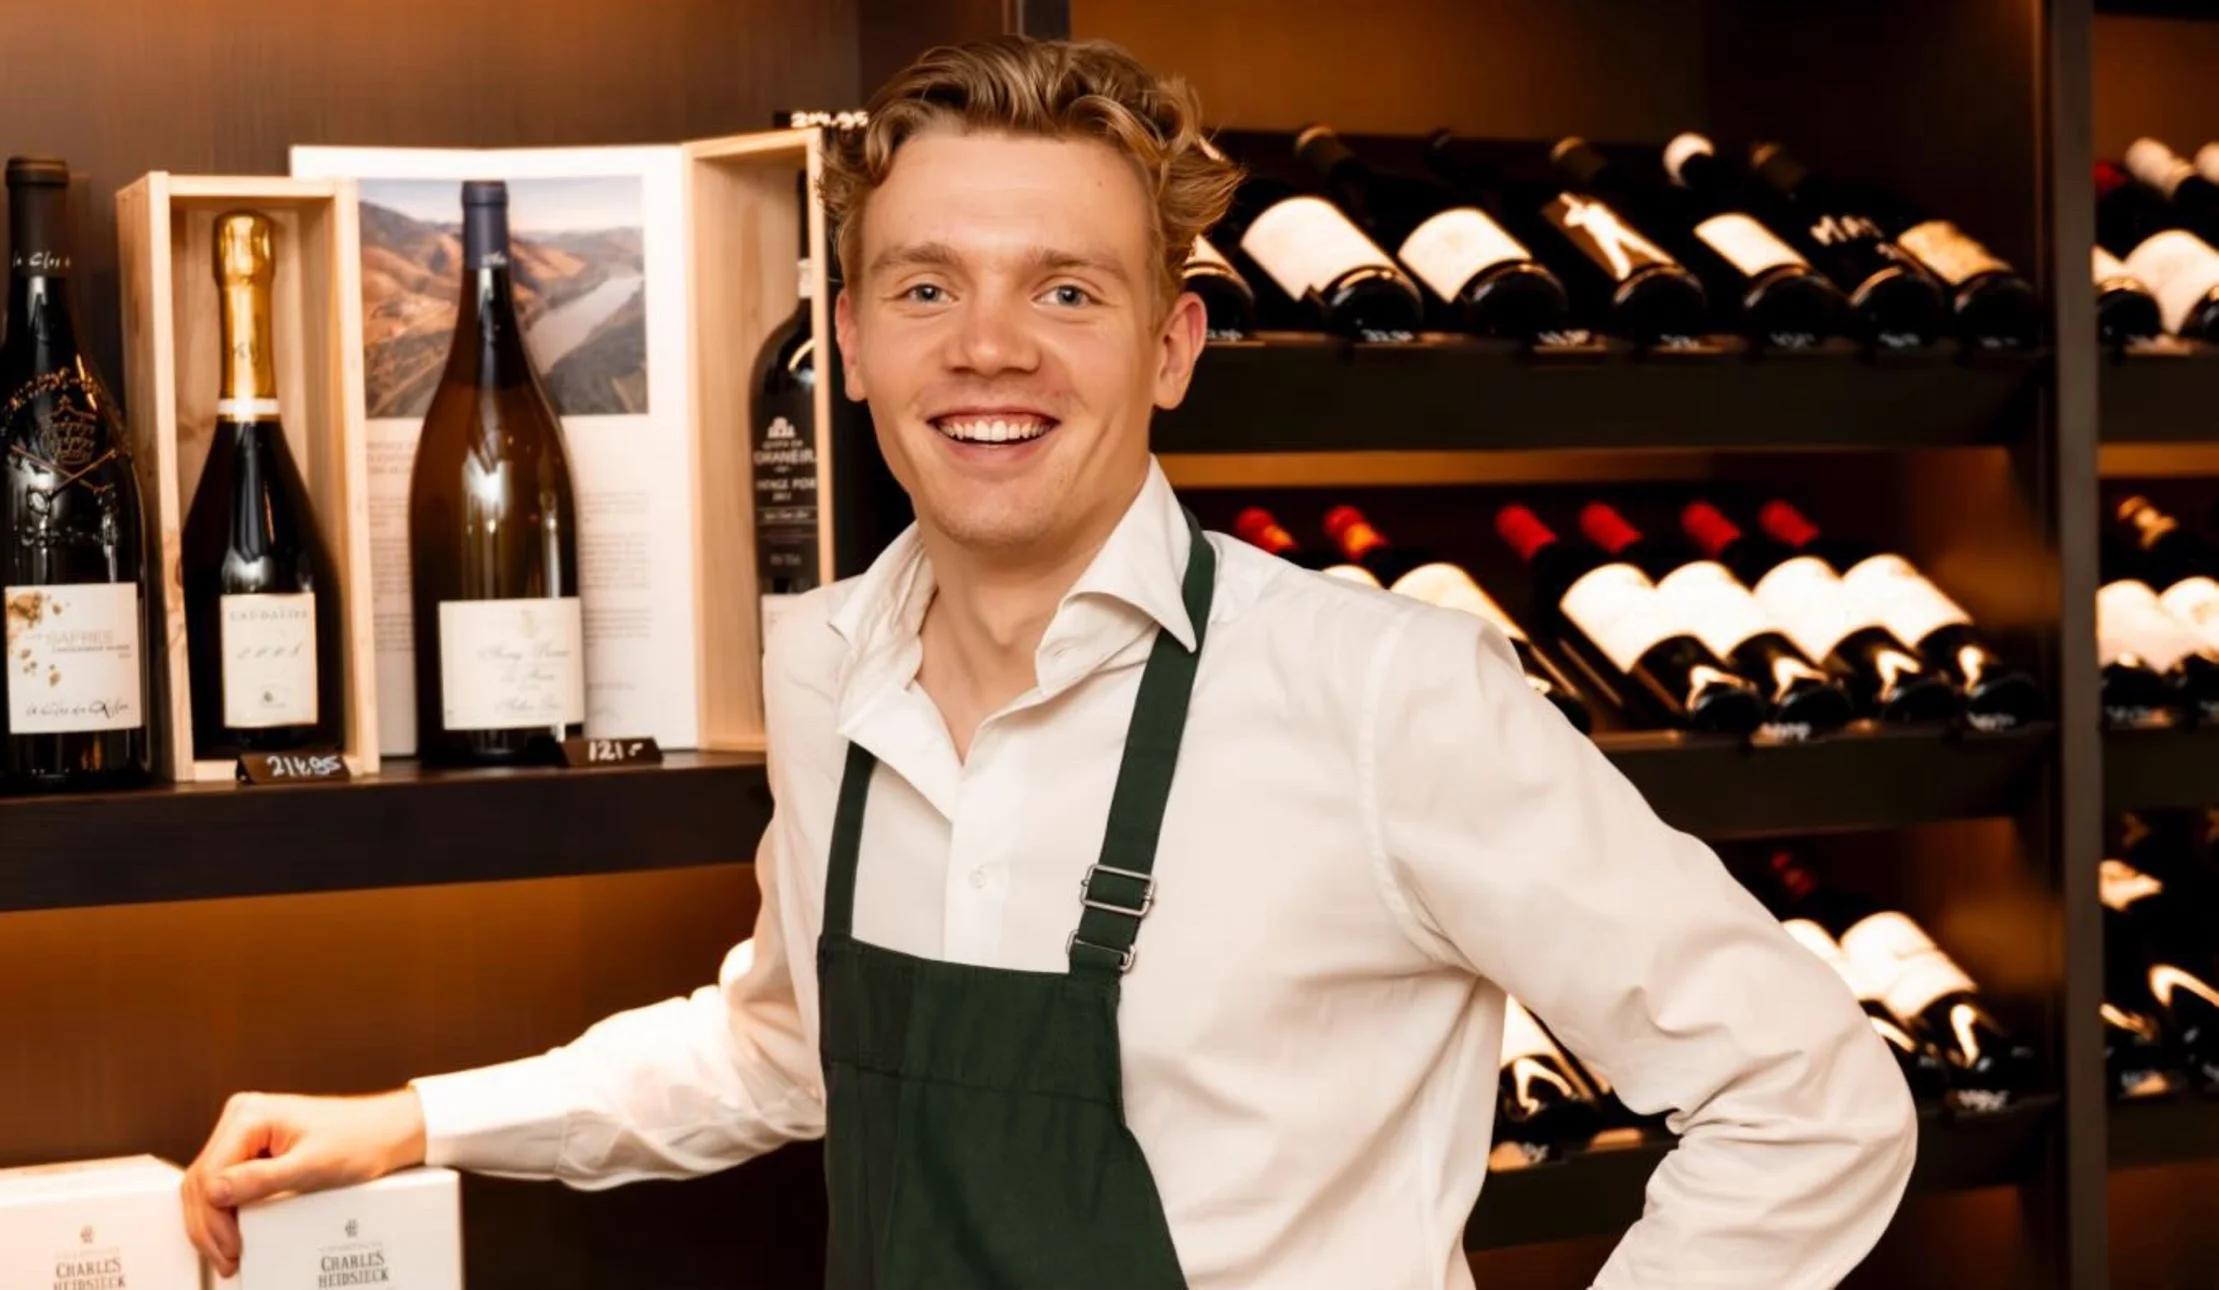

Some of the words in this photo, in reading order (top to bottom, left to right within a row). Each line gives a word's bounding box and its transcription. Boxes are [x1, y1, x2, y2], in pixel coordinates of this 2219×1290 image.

[55, 1256, 122, 1279] CHARLES
[320, 1248, 385, 1272] CHARLES
[318, 1267, 389, 1289] HEIDSIECK
